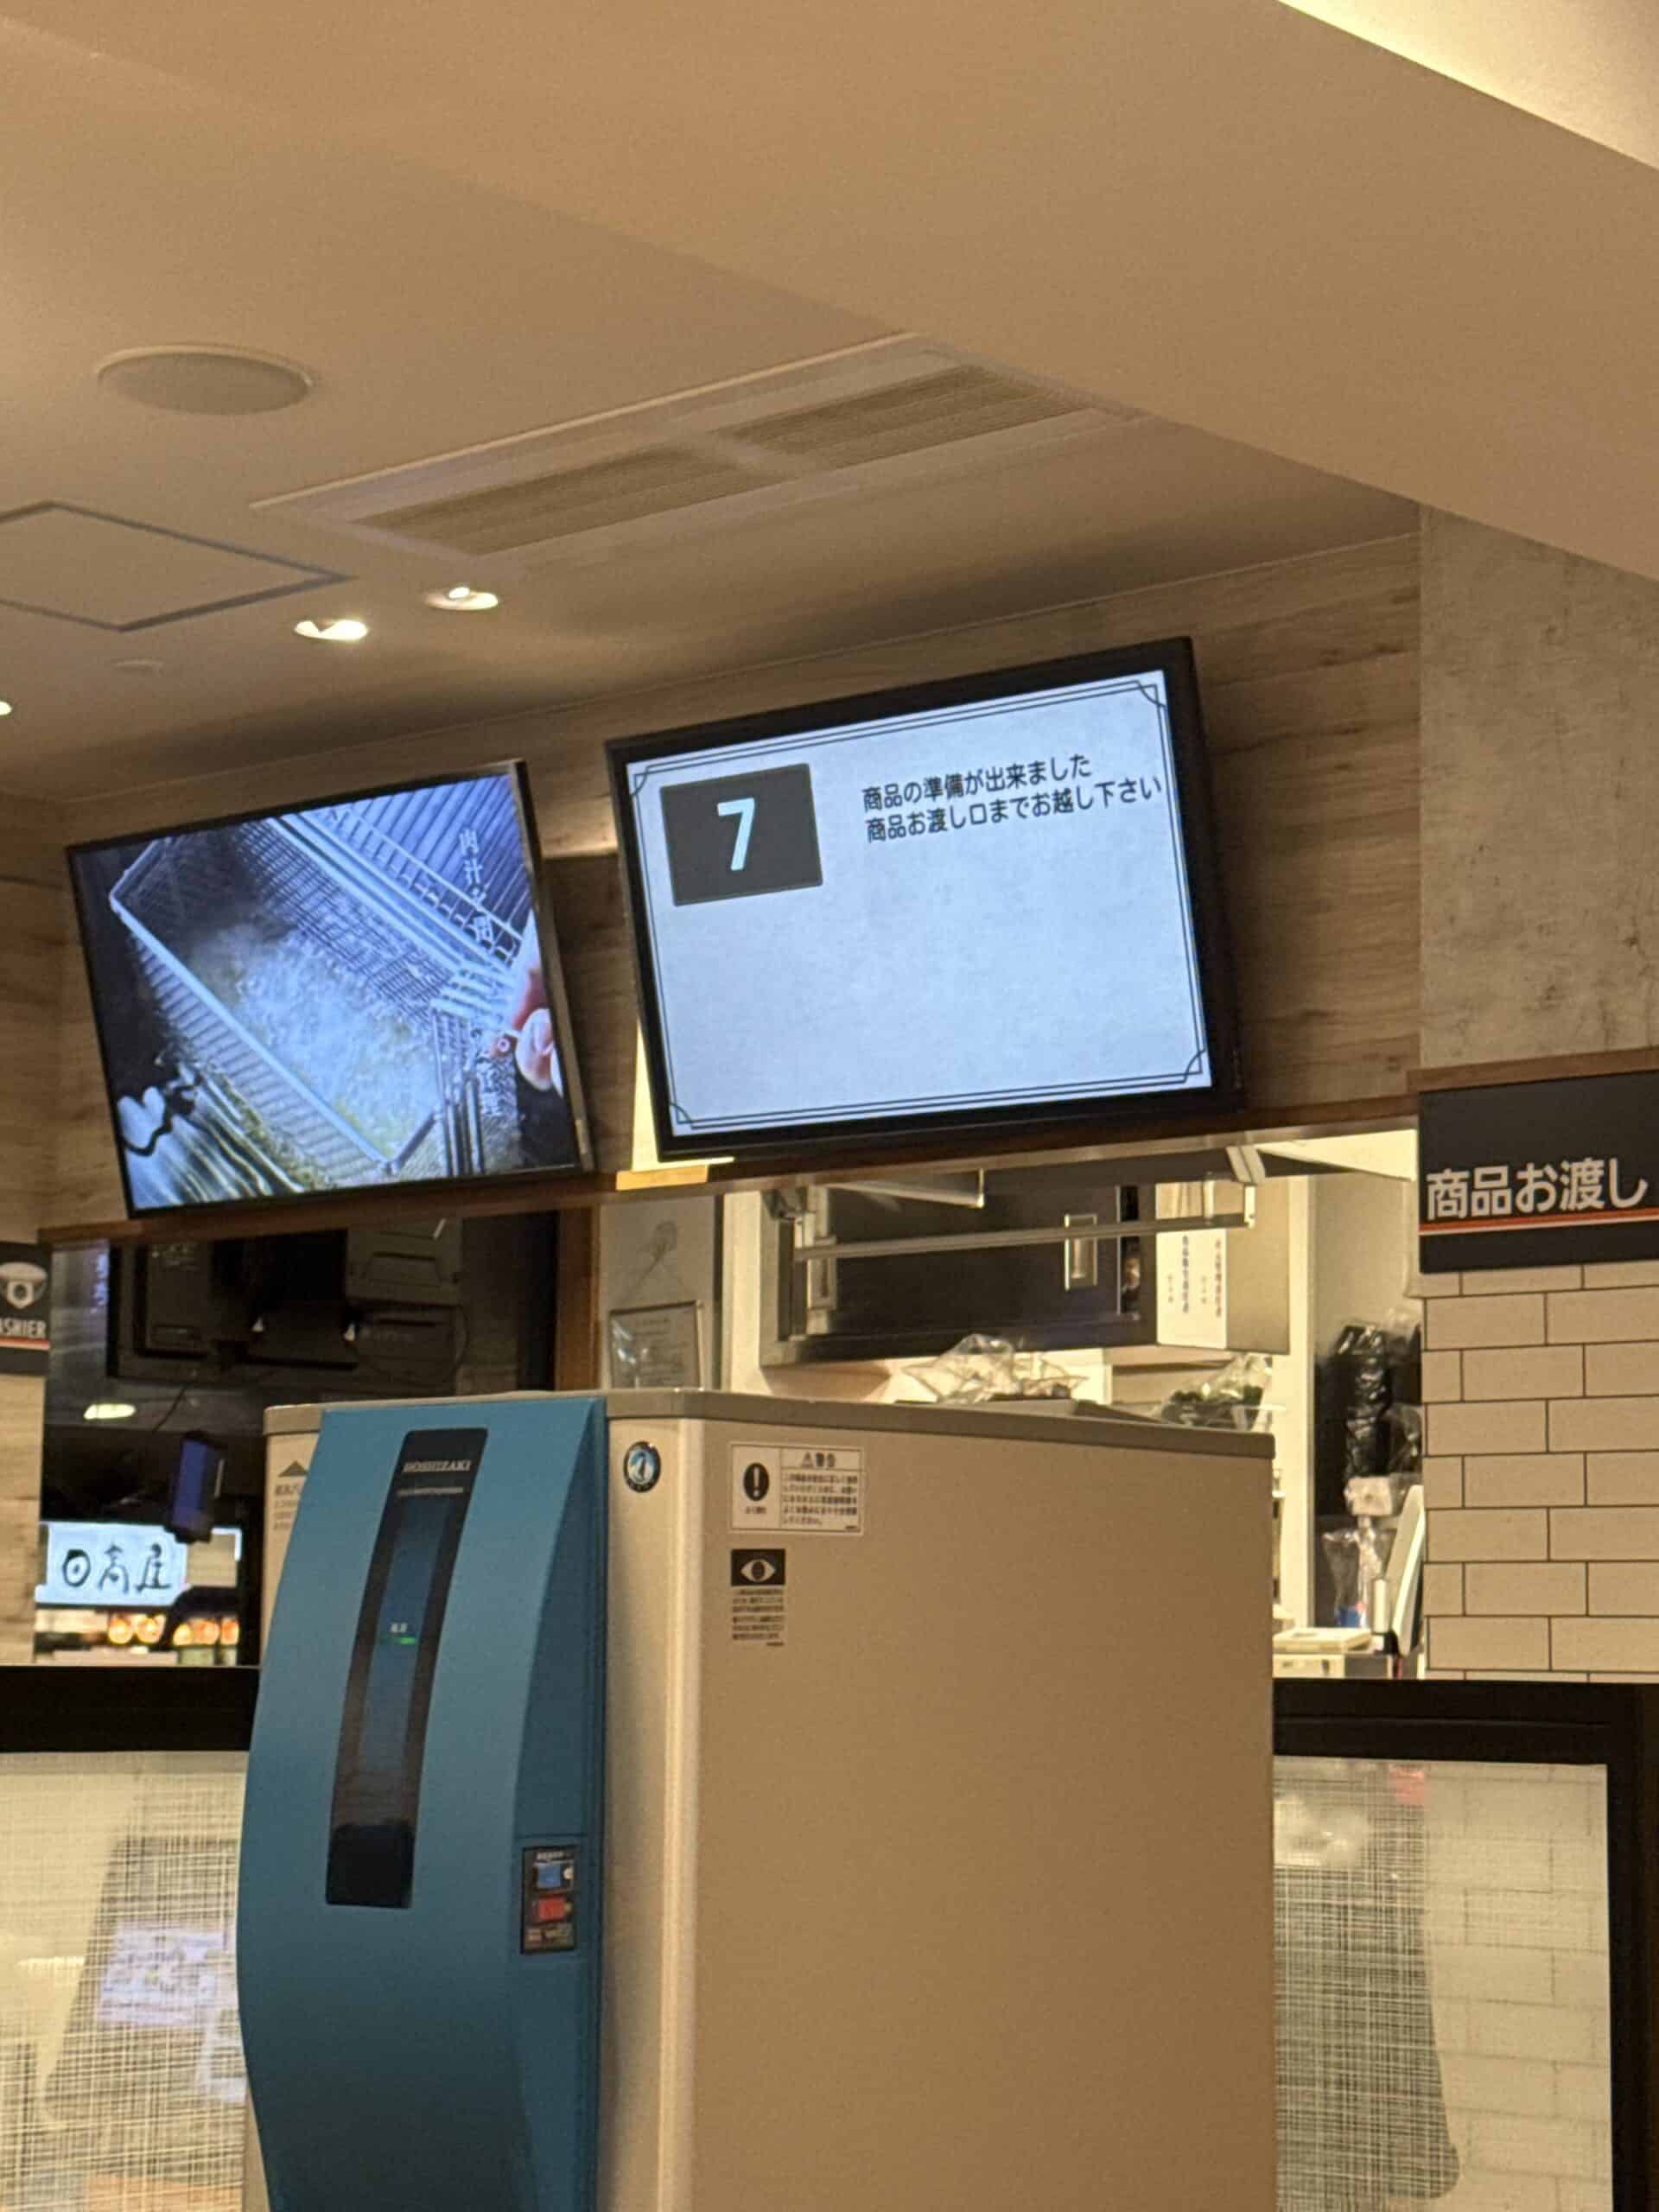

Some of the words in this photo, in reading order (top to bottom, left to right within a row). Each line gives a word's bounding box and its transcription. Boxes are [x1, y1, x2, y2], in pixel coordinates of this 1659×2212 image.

[861, 753, 1092, 812] 商品の準備が出来ました
[866, 776, 1163, 843] 商品お渡し口までお越し下さい
[717, 797, 755, 871] 7
[1426, 1157, 1649, 1221] 商品お渡し
[0, 1318, 46, 1338] SHIER
